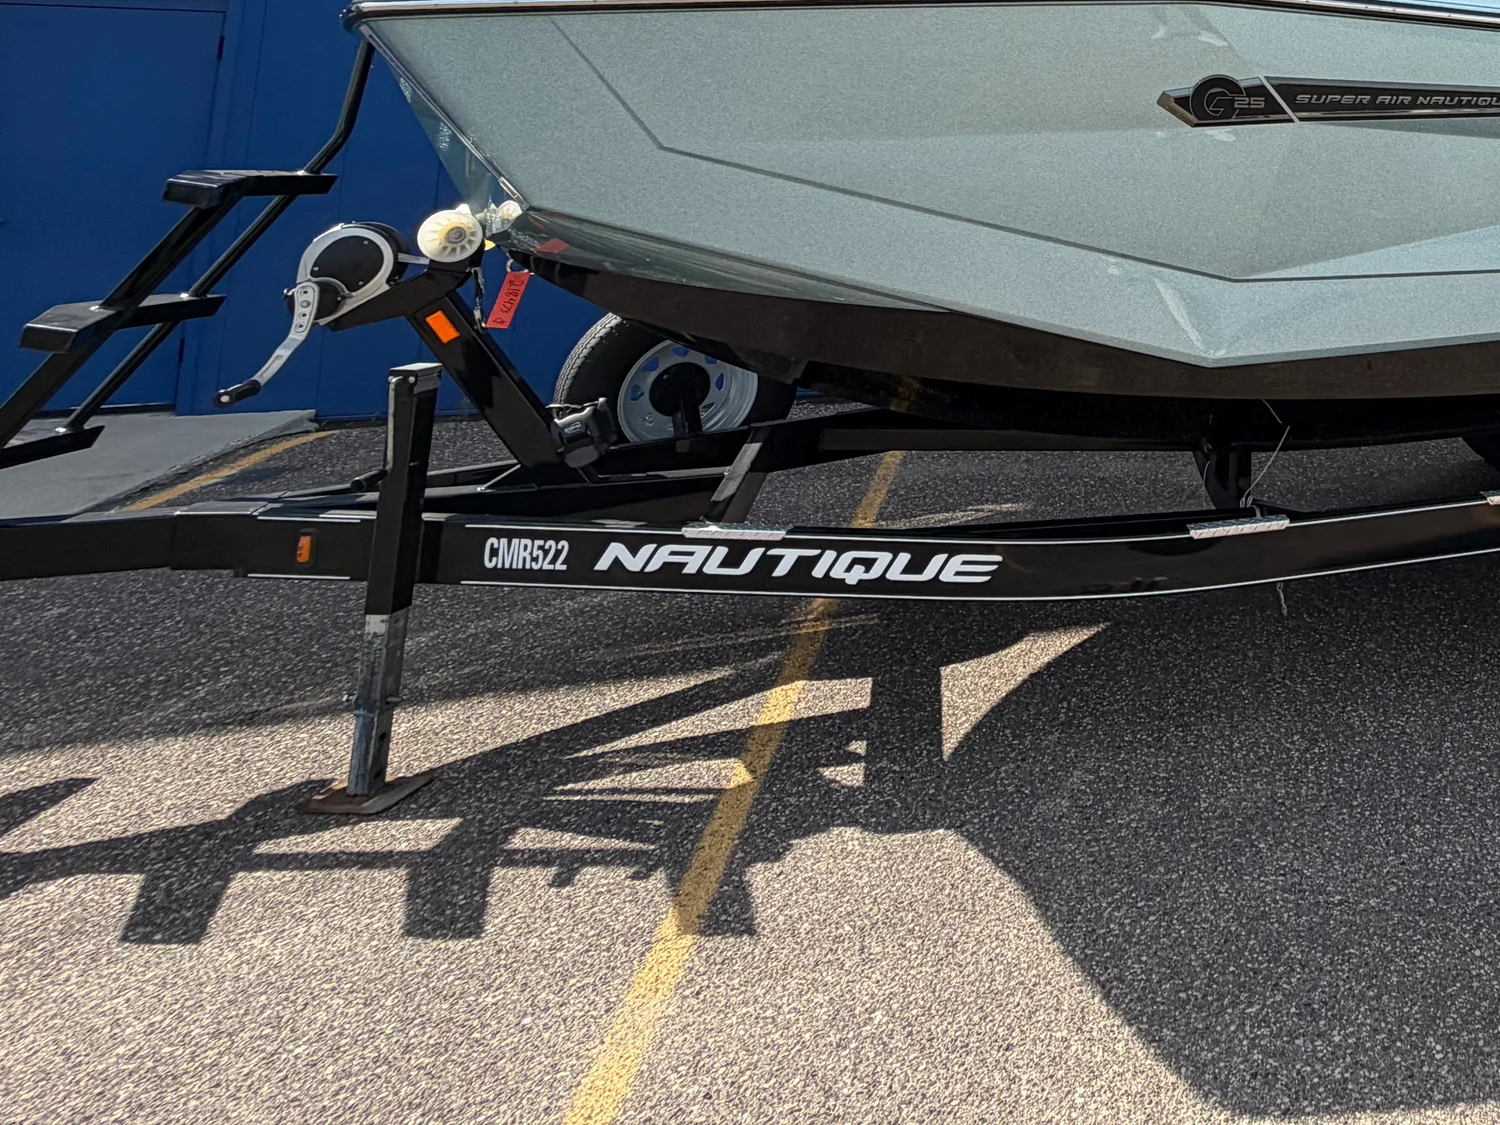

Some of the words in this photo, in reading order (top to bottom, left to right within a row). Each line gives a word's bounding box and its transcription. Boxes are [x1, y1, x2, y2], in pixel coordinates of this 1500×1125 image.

[1294, 94, 1371, 104] SUPER
[1375, 95, 1413, 105] AIR
[483, 537, 569, 571] CMR522
[593, 542, 1003, 585] NAUTIQUE
